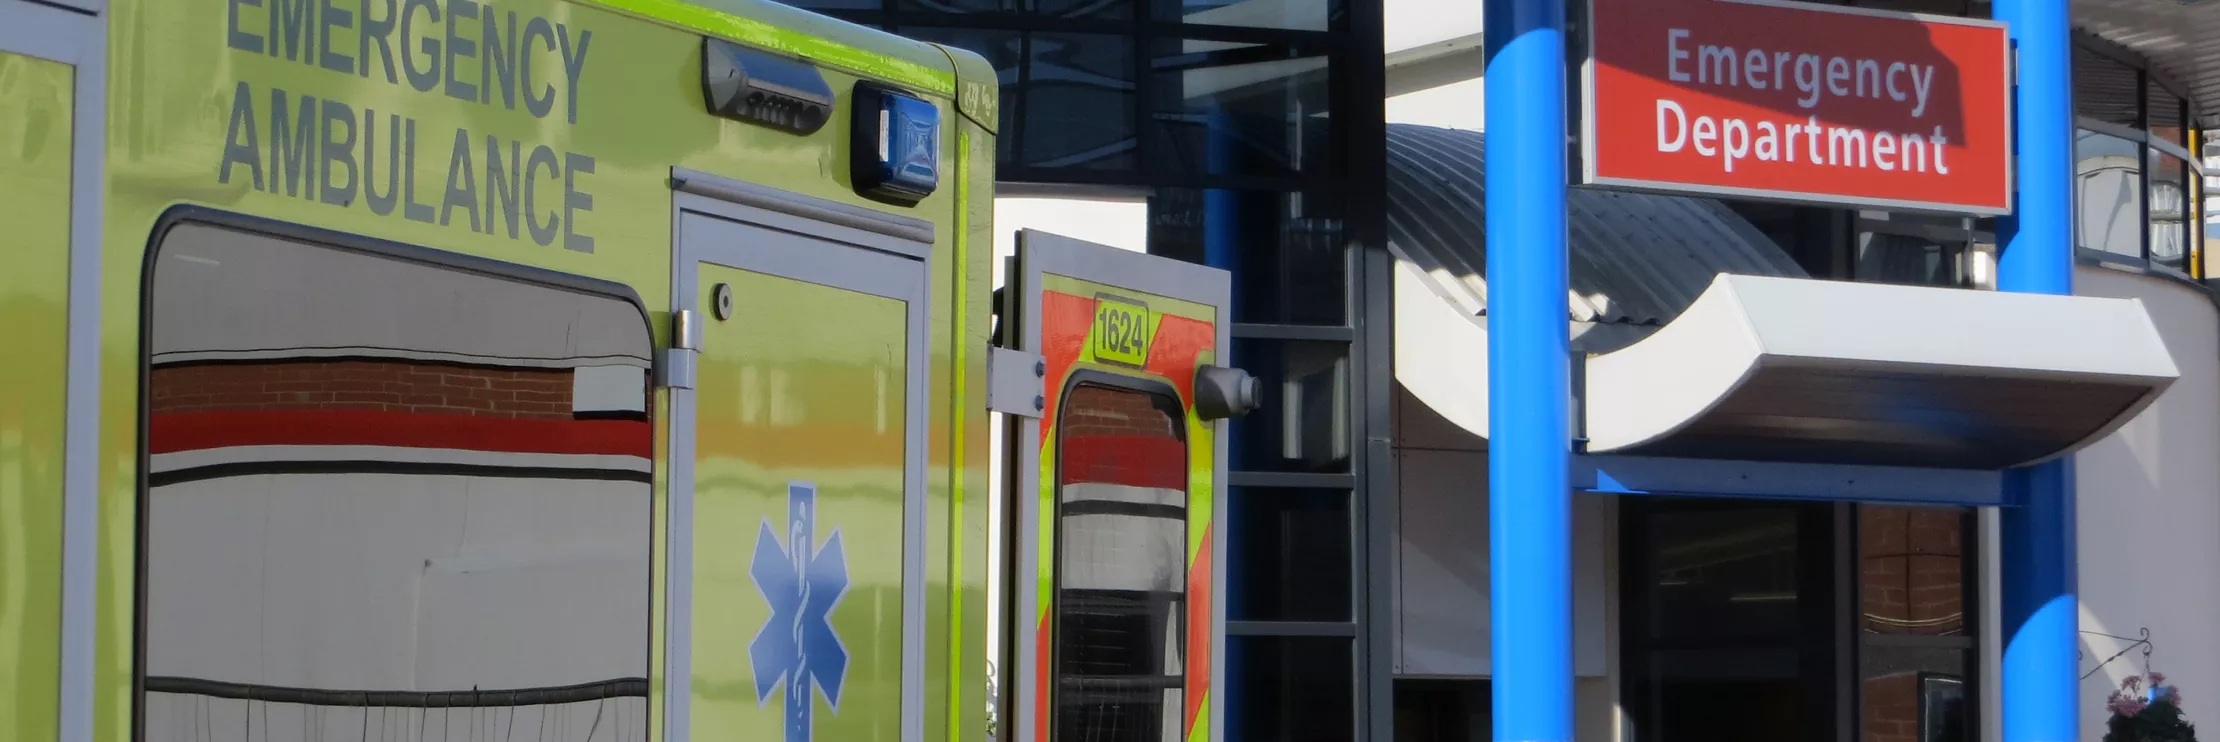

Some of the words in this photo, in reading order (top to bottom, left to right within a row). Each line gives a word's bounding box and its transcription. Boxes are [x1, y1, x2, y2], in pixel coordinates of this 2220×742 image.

[1667, 28, 1933, 117] Emergency
[218, 81, 595, 253] AMBULANCE
[1656, 99, 1948, 174] Department
[1099, 307, 1143, 356] 1624
